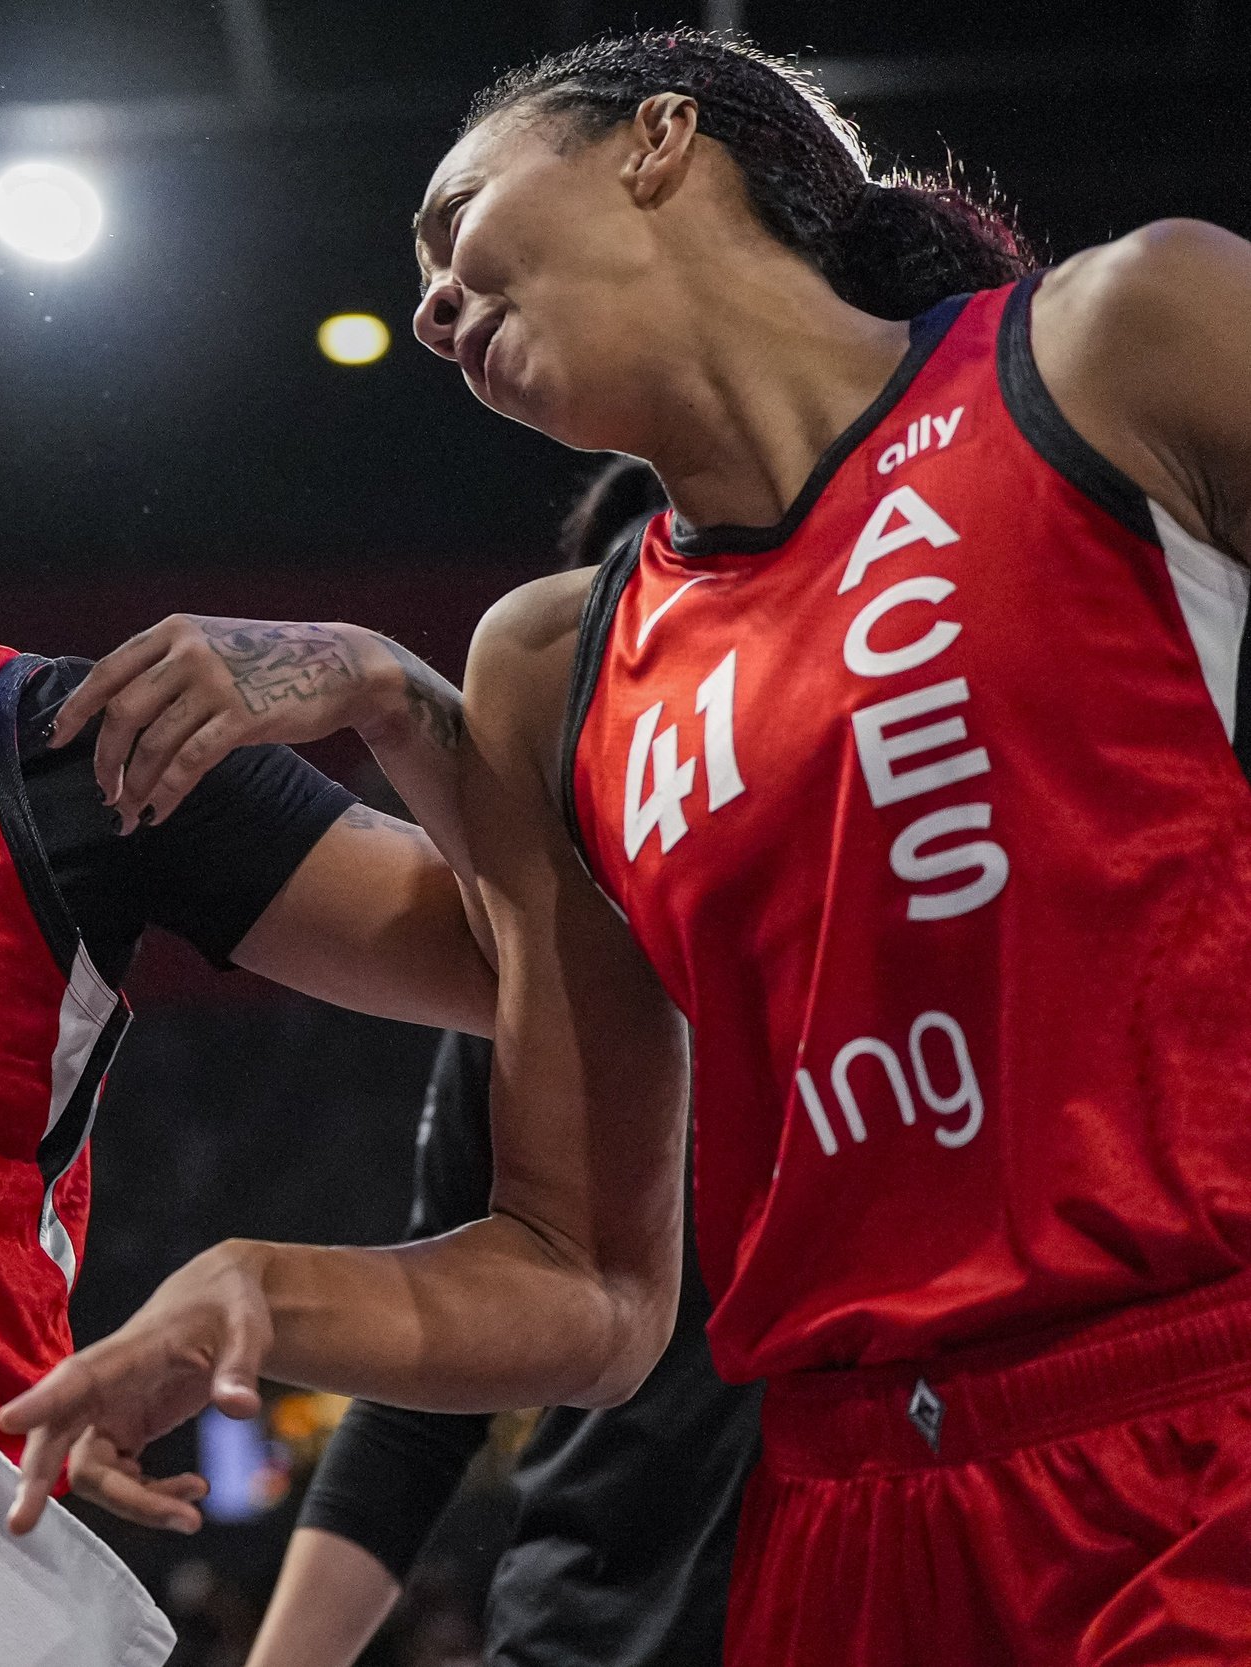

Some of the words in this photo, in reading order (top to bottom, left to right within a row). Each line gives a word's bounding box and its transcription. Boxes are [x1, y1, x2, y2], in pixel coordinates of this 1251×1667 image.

[876, 405, 965, 475] ally
[623, 647, 746, 863] 41
[837, 484, 1010, 921] ACES
